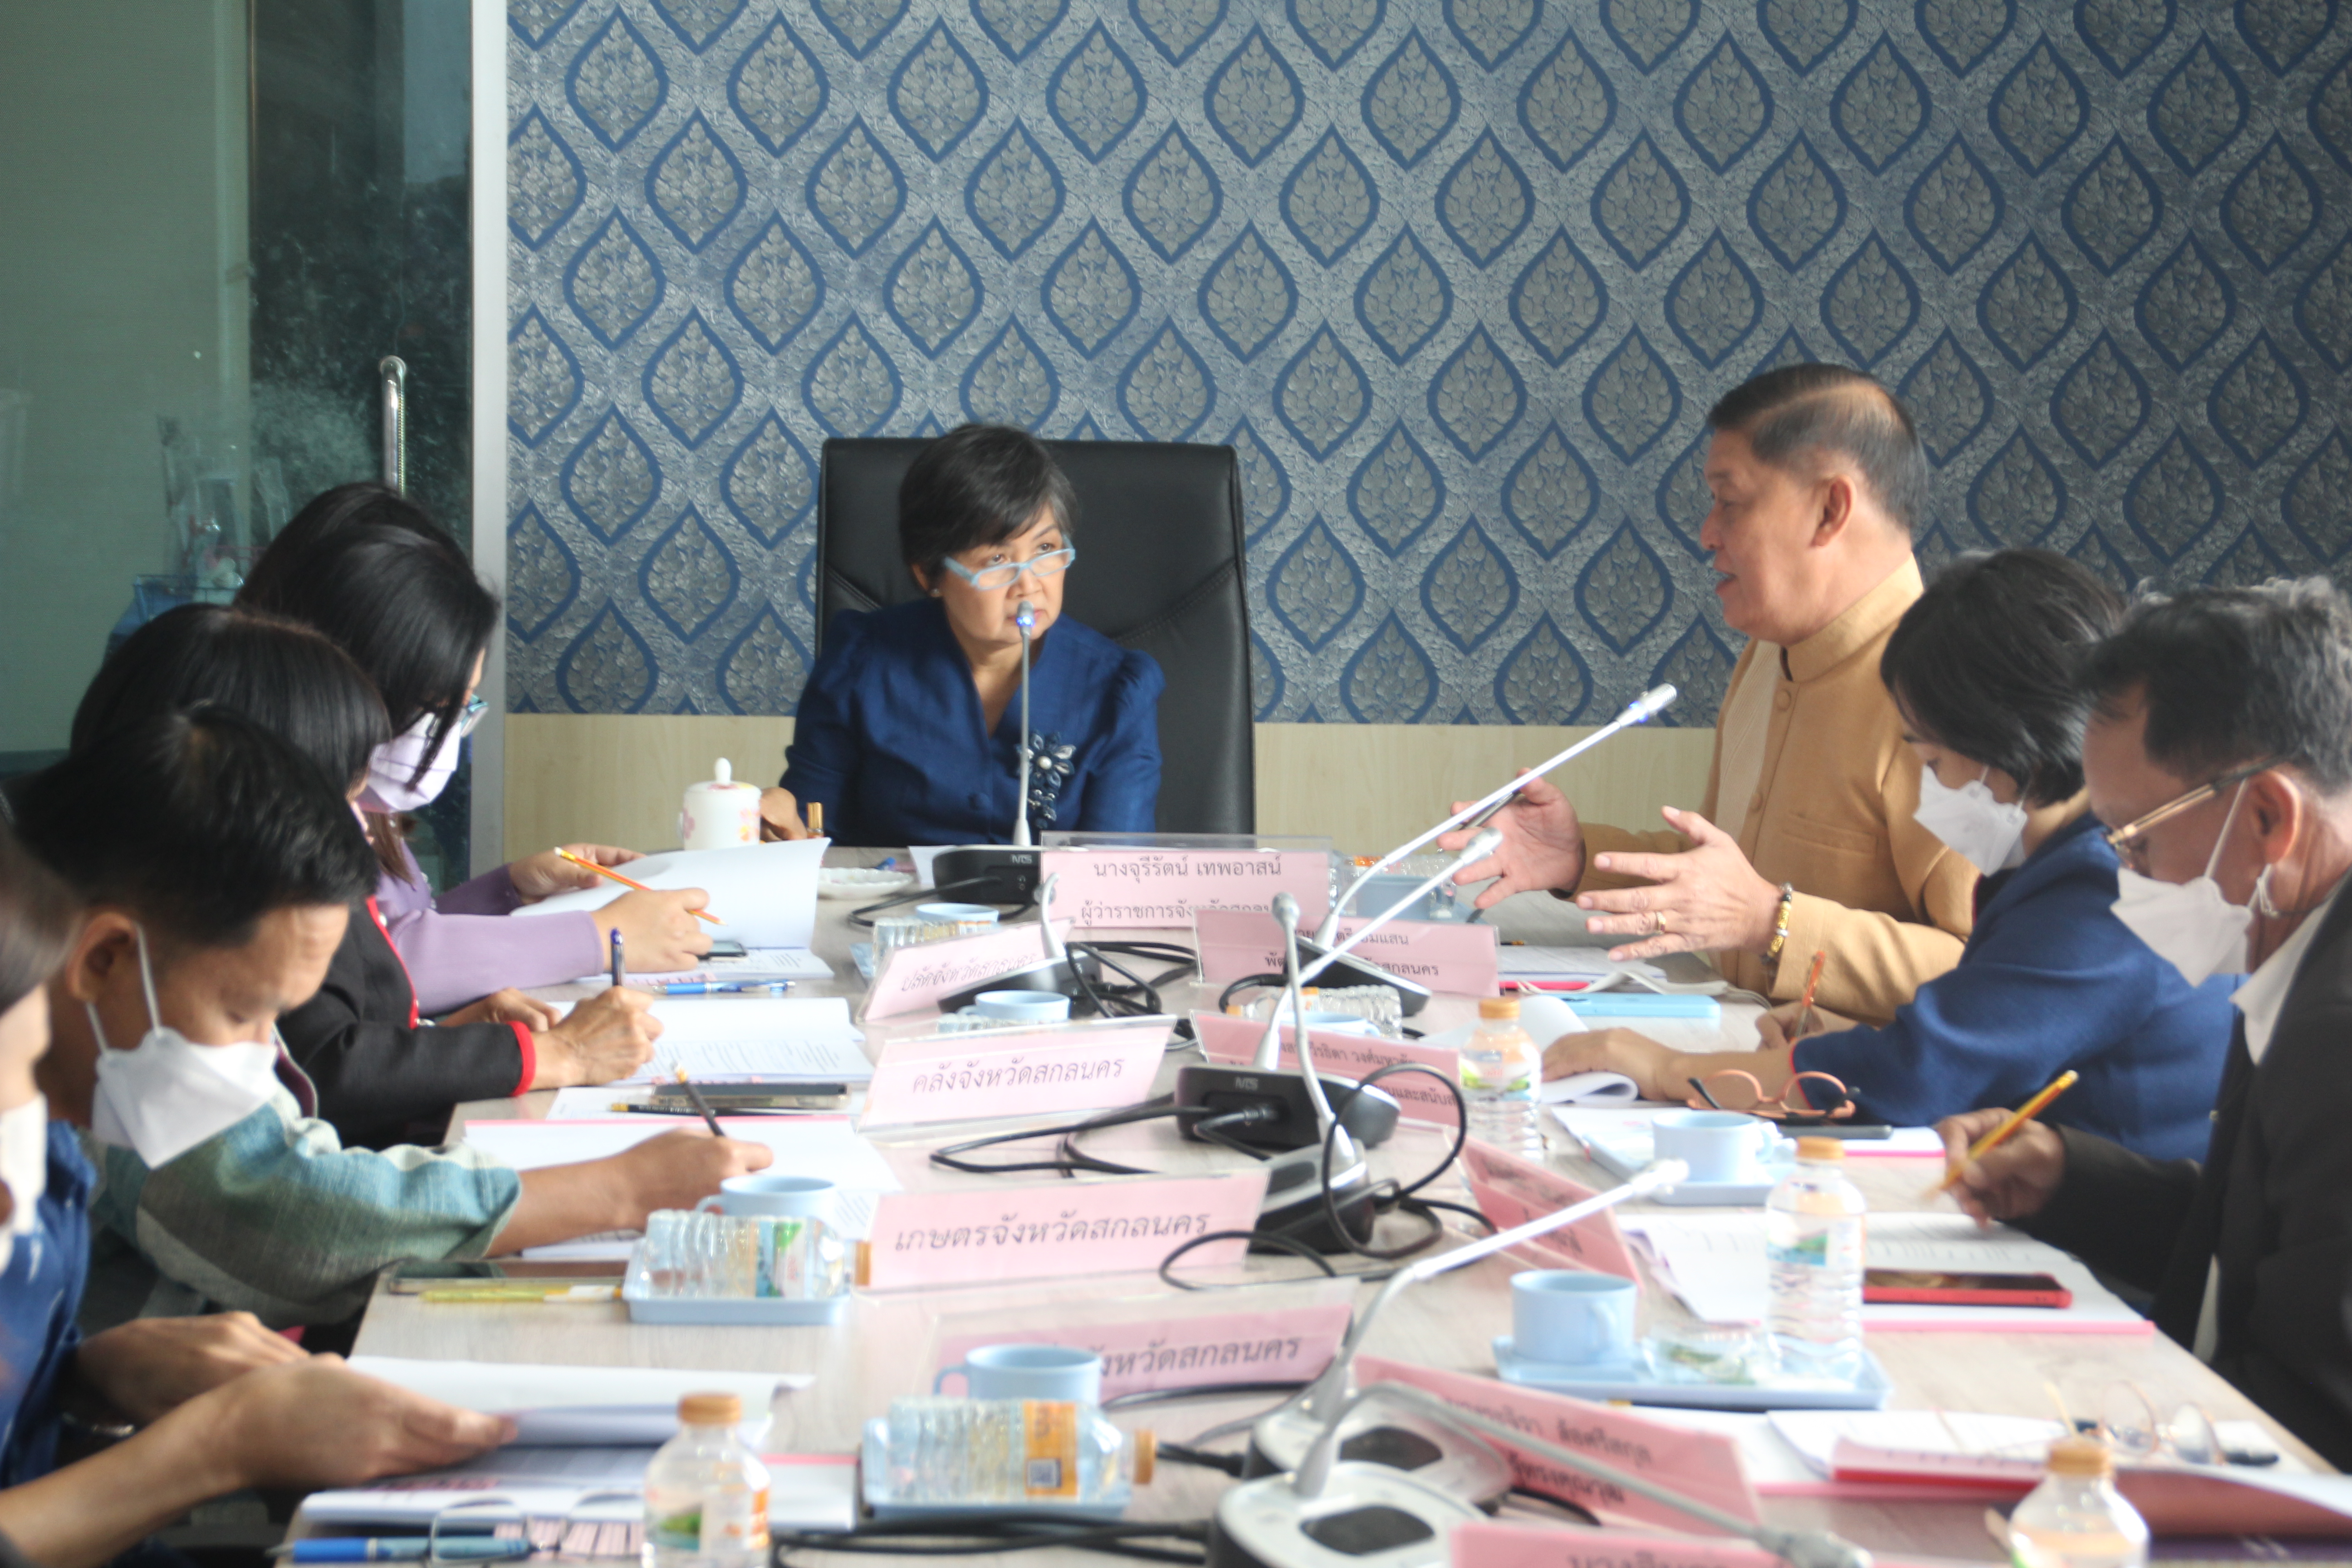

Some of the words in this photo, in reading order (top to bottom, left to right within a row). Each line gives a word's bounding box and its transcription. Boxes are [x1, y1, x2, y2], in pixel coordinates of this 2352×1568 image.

[1093, 855, 1189, 883] นางจุรีรัตน์
[1197, 854, 1282, 877] เทพอาสน์
[912, 1056, 1125, 1093] คลังจังหวัดสกลนคร
[895, 1209, 1210, 1252] เกษตรจังหวัดสกลนคร
